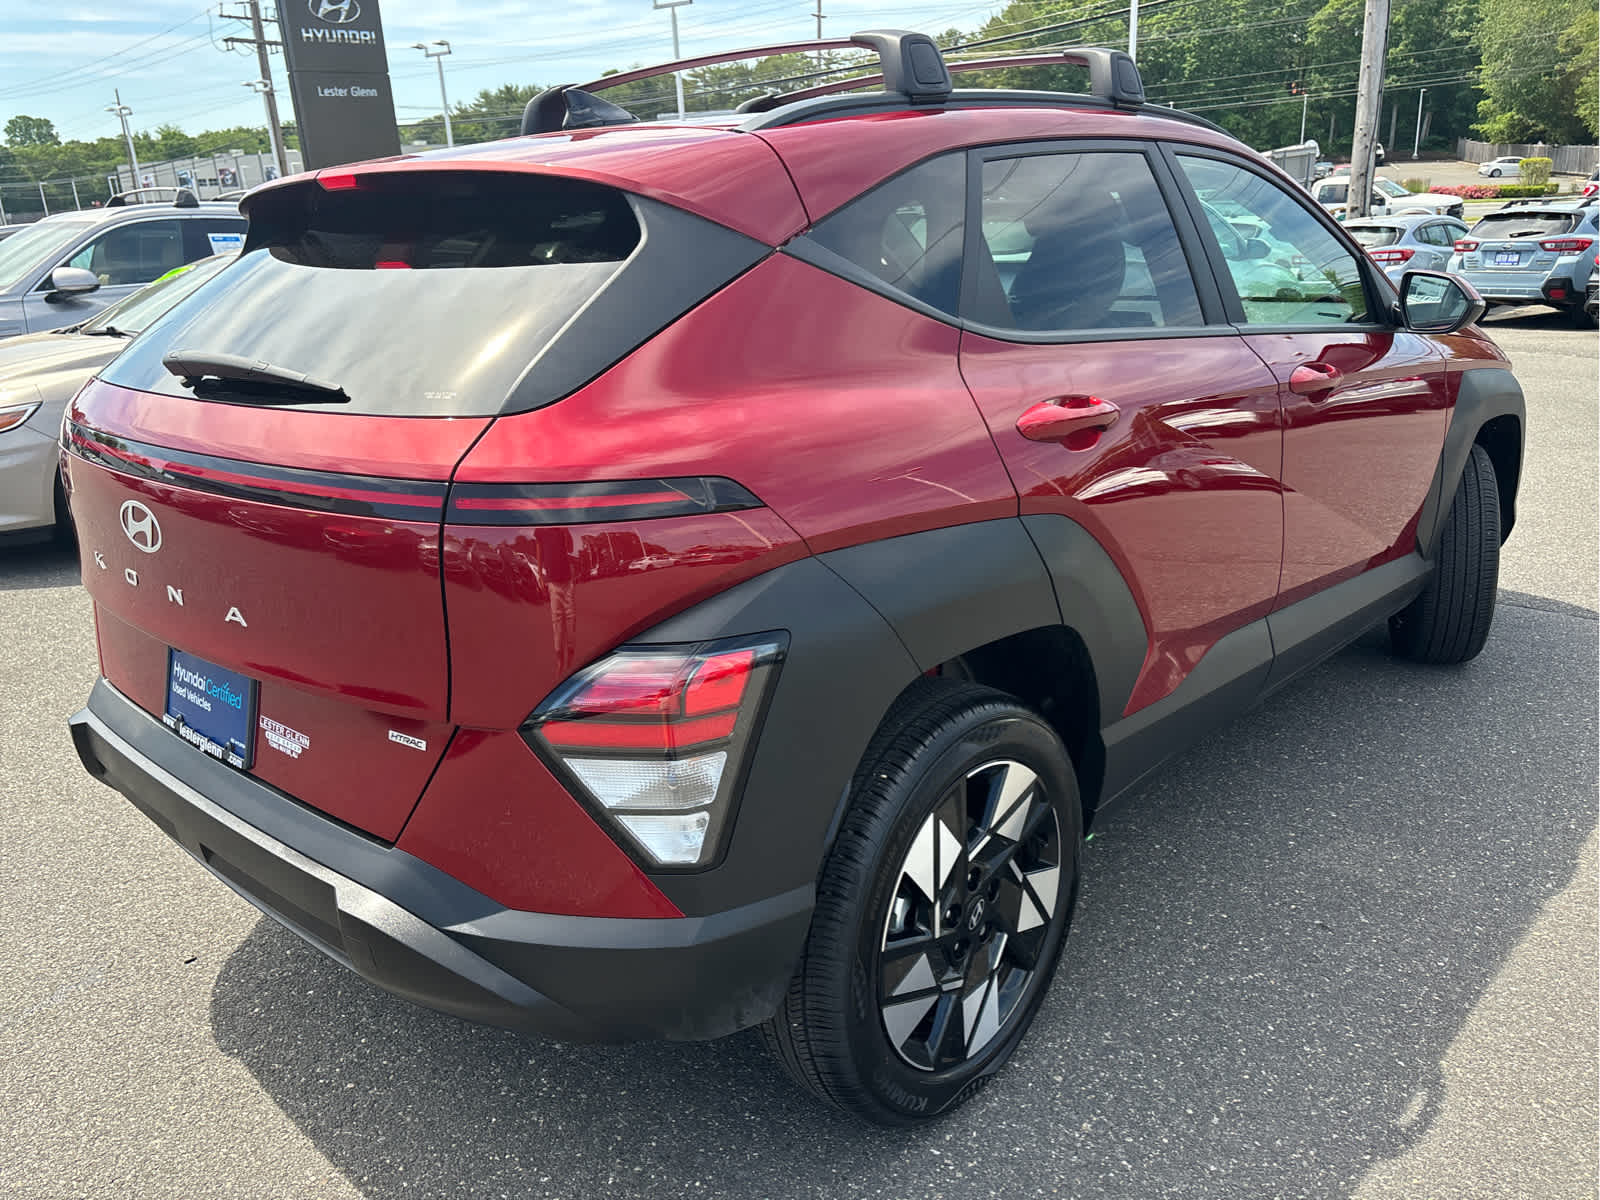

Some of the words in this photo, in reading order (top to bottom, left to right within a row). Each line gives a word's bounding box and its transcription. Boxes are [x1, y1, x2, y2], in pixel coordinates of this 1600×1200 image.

[301, 28, 376, 44] HYUNDAI
[317, 86, 347, 97] Lester
[350, 86, 378, 97] Glenn
[94, 551, 248, 628] KONA
[172, 681, 187, 698] Used
[187, 689, 211, 712] Vehicles
[173, 660, 206, 691] Hyundai
[206, 679, 242, 709] Certified
[390, 732, 423, 749] HTRAC
